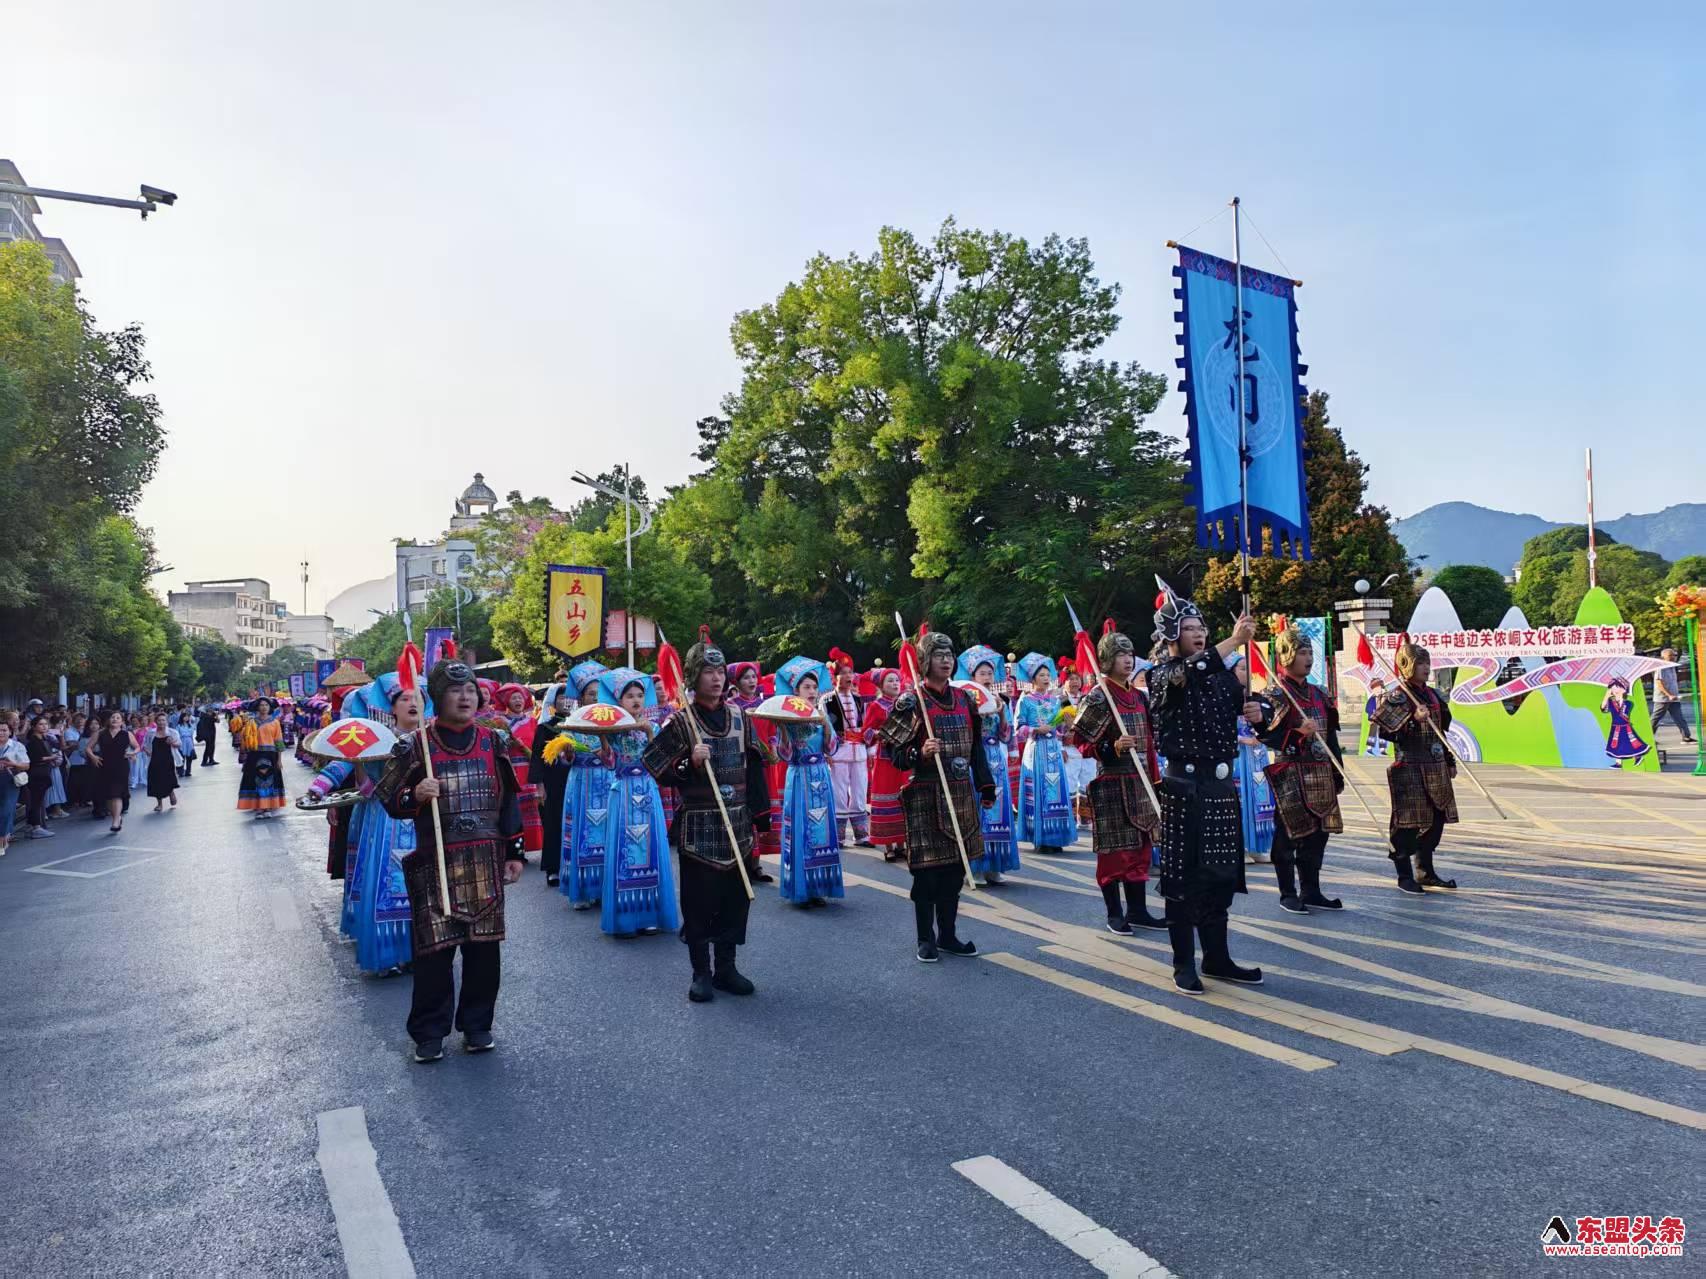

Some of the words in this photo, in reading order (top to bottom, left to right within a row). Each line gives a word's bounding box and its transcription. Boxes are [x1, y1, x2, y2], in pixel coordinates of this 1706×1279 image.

[566, 579, 587, 646] 五山乡
[591, 706, 616, 722] 新
[337, 725, 367, 746] 大
